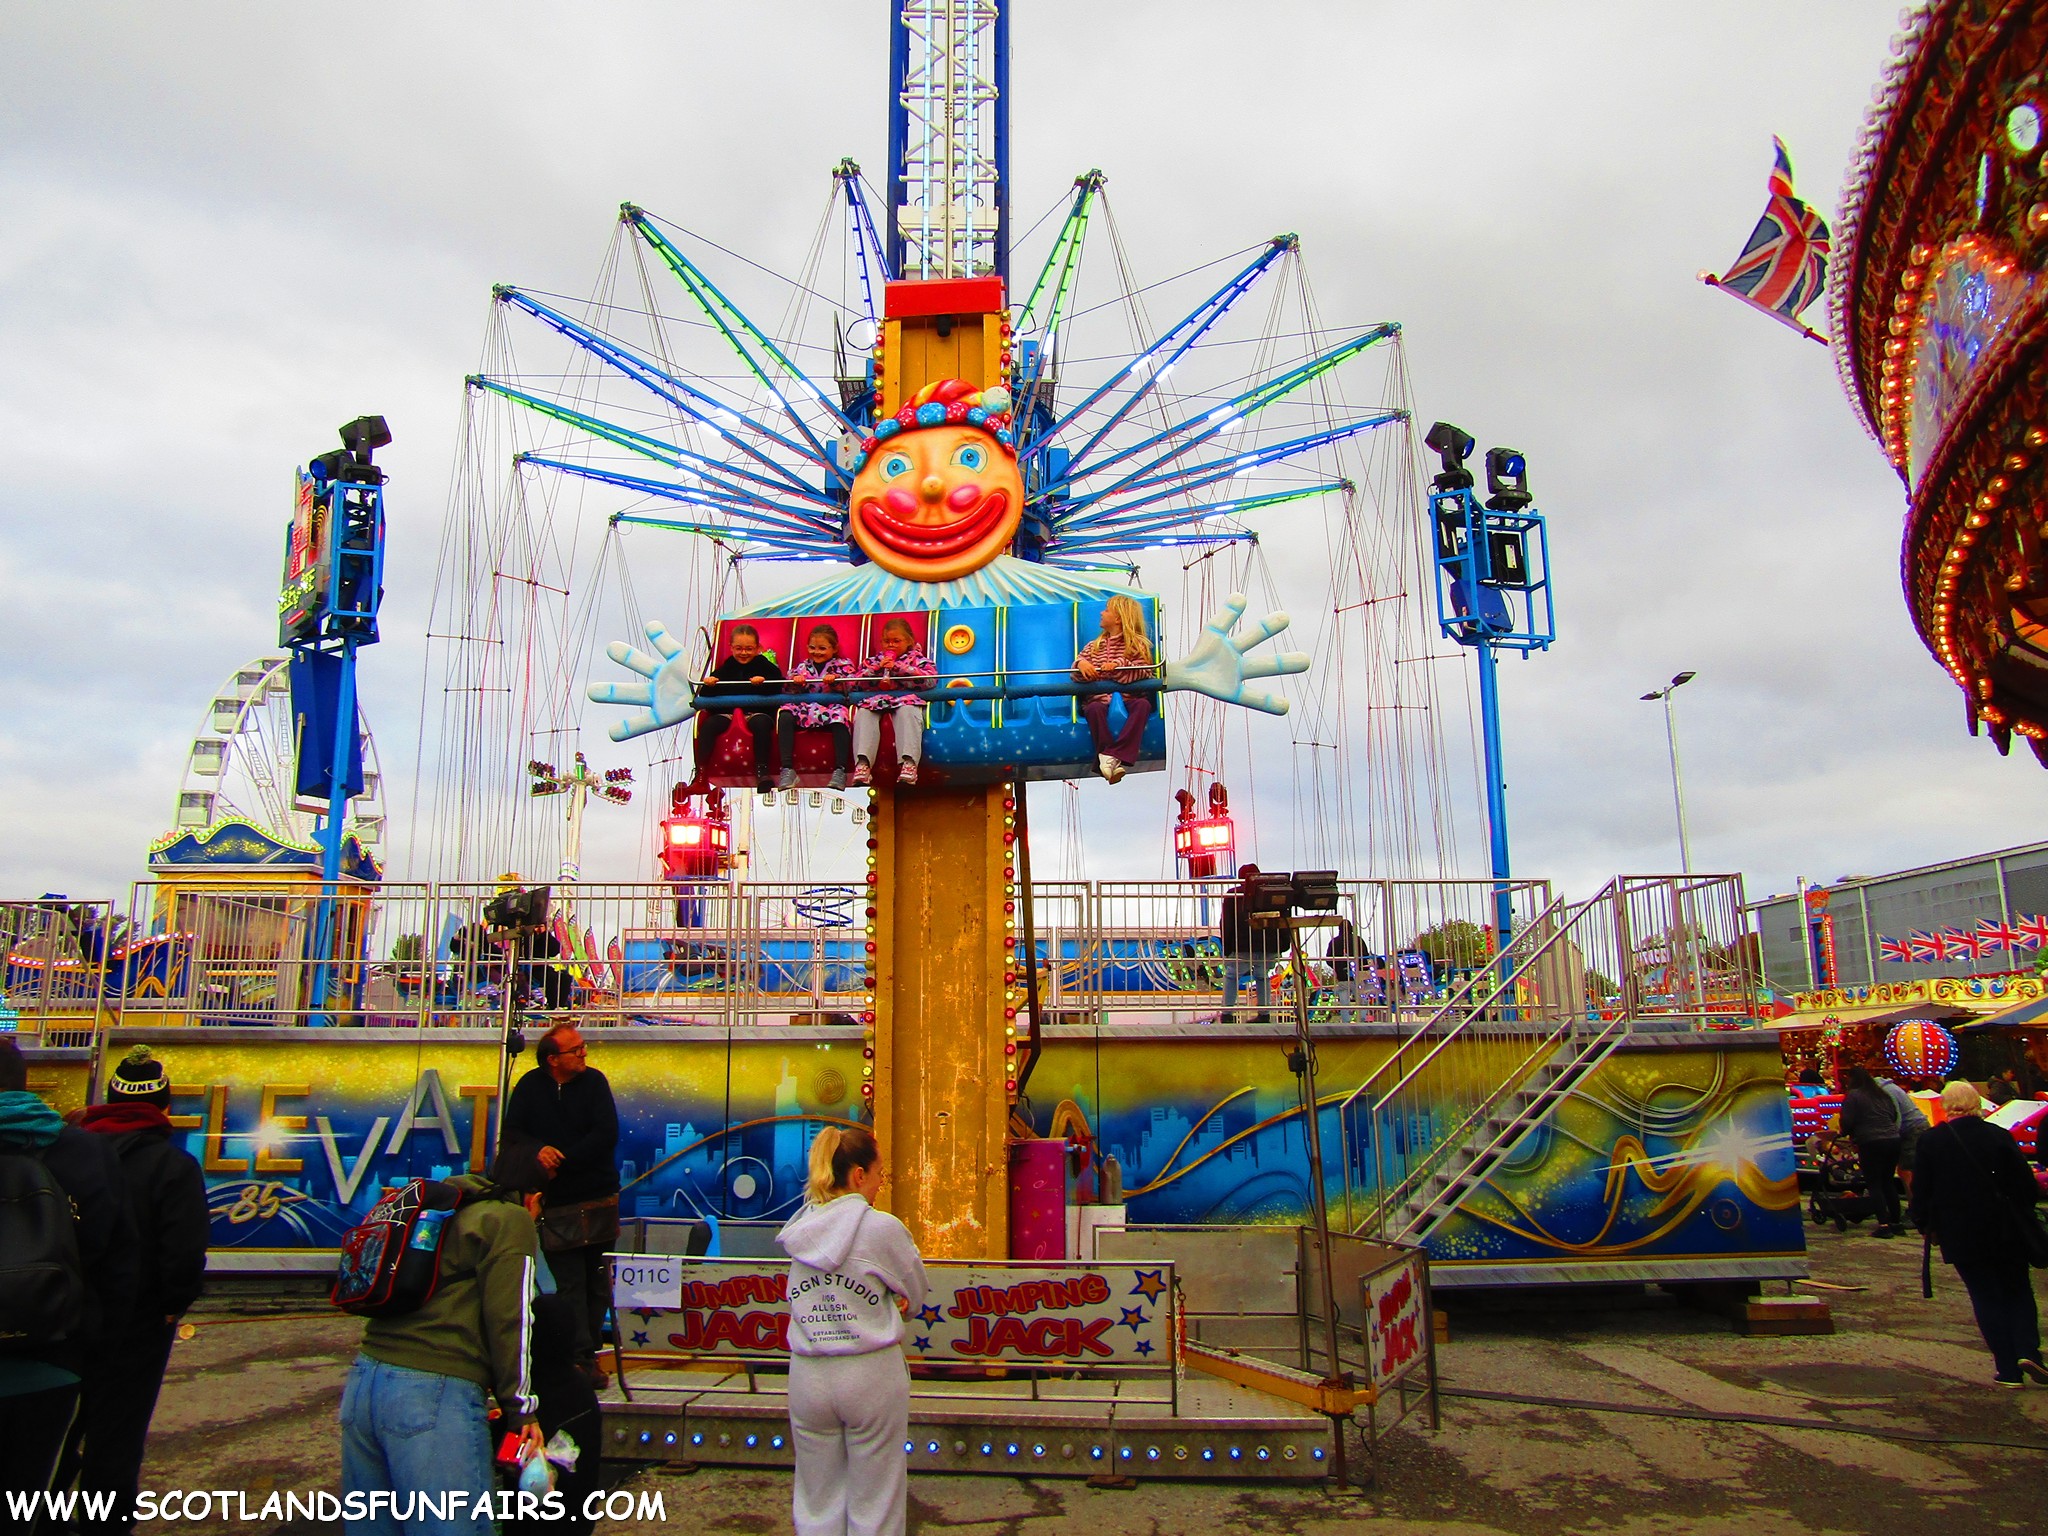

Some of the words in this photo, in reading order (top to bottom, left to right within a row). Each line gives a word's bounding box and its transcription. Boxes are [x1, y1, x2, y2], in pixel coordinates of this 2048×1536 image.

[226, 1181, 283, 1224] 85
[621, 1267, 670, 1286] Q11C
[667, 1274, 790, 1313] UMPIN
[824, 1273, 879, 1306] STUDIO
[811, 1304, 829, 1313] ALL
[948, 1274, 1111, 1319] JUMPING
[800, 1312, 858, 1324] COLLECTION
[951, 1316, 1114, 1357] JACK
